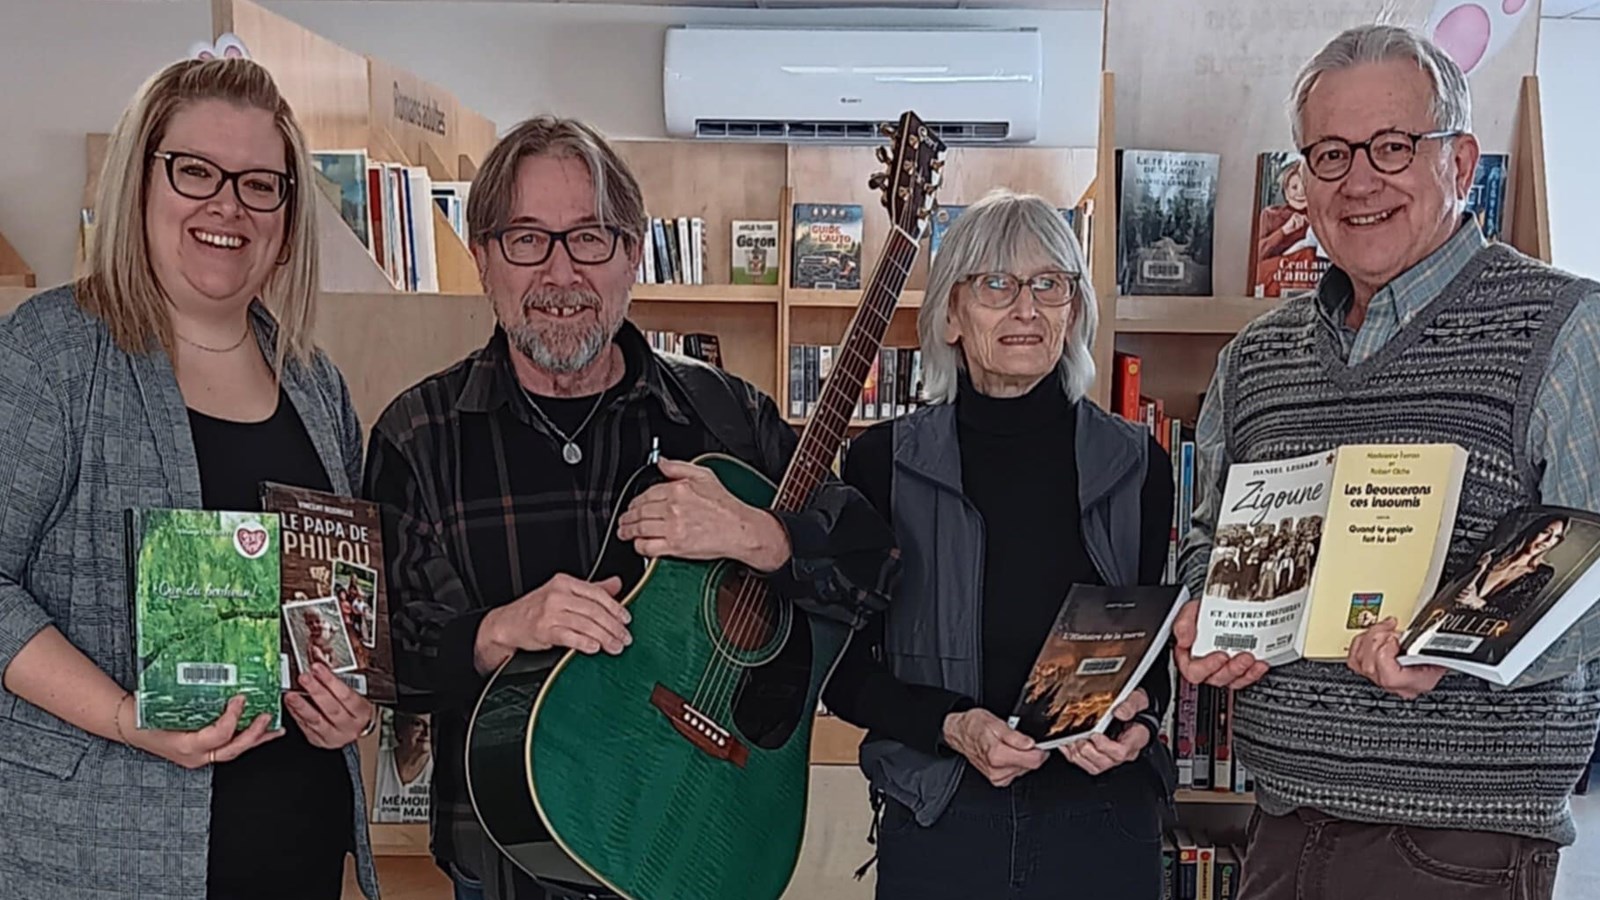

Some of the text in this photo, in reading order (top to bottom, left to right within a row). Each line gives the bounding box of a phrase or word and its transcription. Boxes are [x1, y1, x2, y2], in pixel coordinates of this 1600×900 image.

[810, 224, 842, 234] GUIDE
[1279, 258, 1309, 269] Cent
[1344, 483, 1432, 495] Les Beaucerons
[1231, 480, 1324, 527] Zigoune
[1350, 496, 1421, 508] ces insoumis
[281, 511, 369, 543] LE PAPA DE
[1348, 524, 1414, 535] Quand le peuple
[283, 530, 370, 567] PHILOU
[1209, 610, 1223, 618] ET
[1226, 609, 1264, 619] AUTRES
[1231, 619, 1256, 628] PAYS
[1103, 632, 1113, 640] de
[1114, 632, 1122, 640] la
